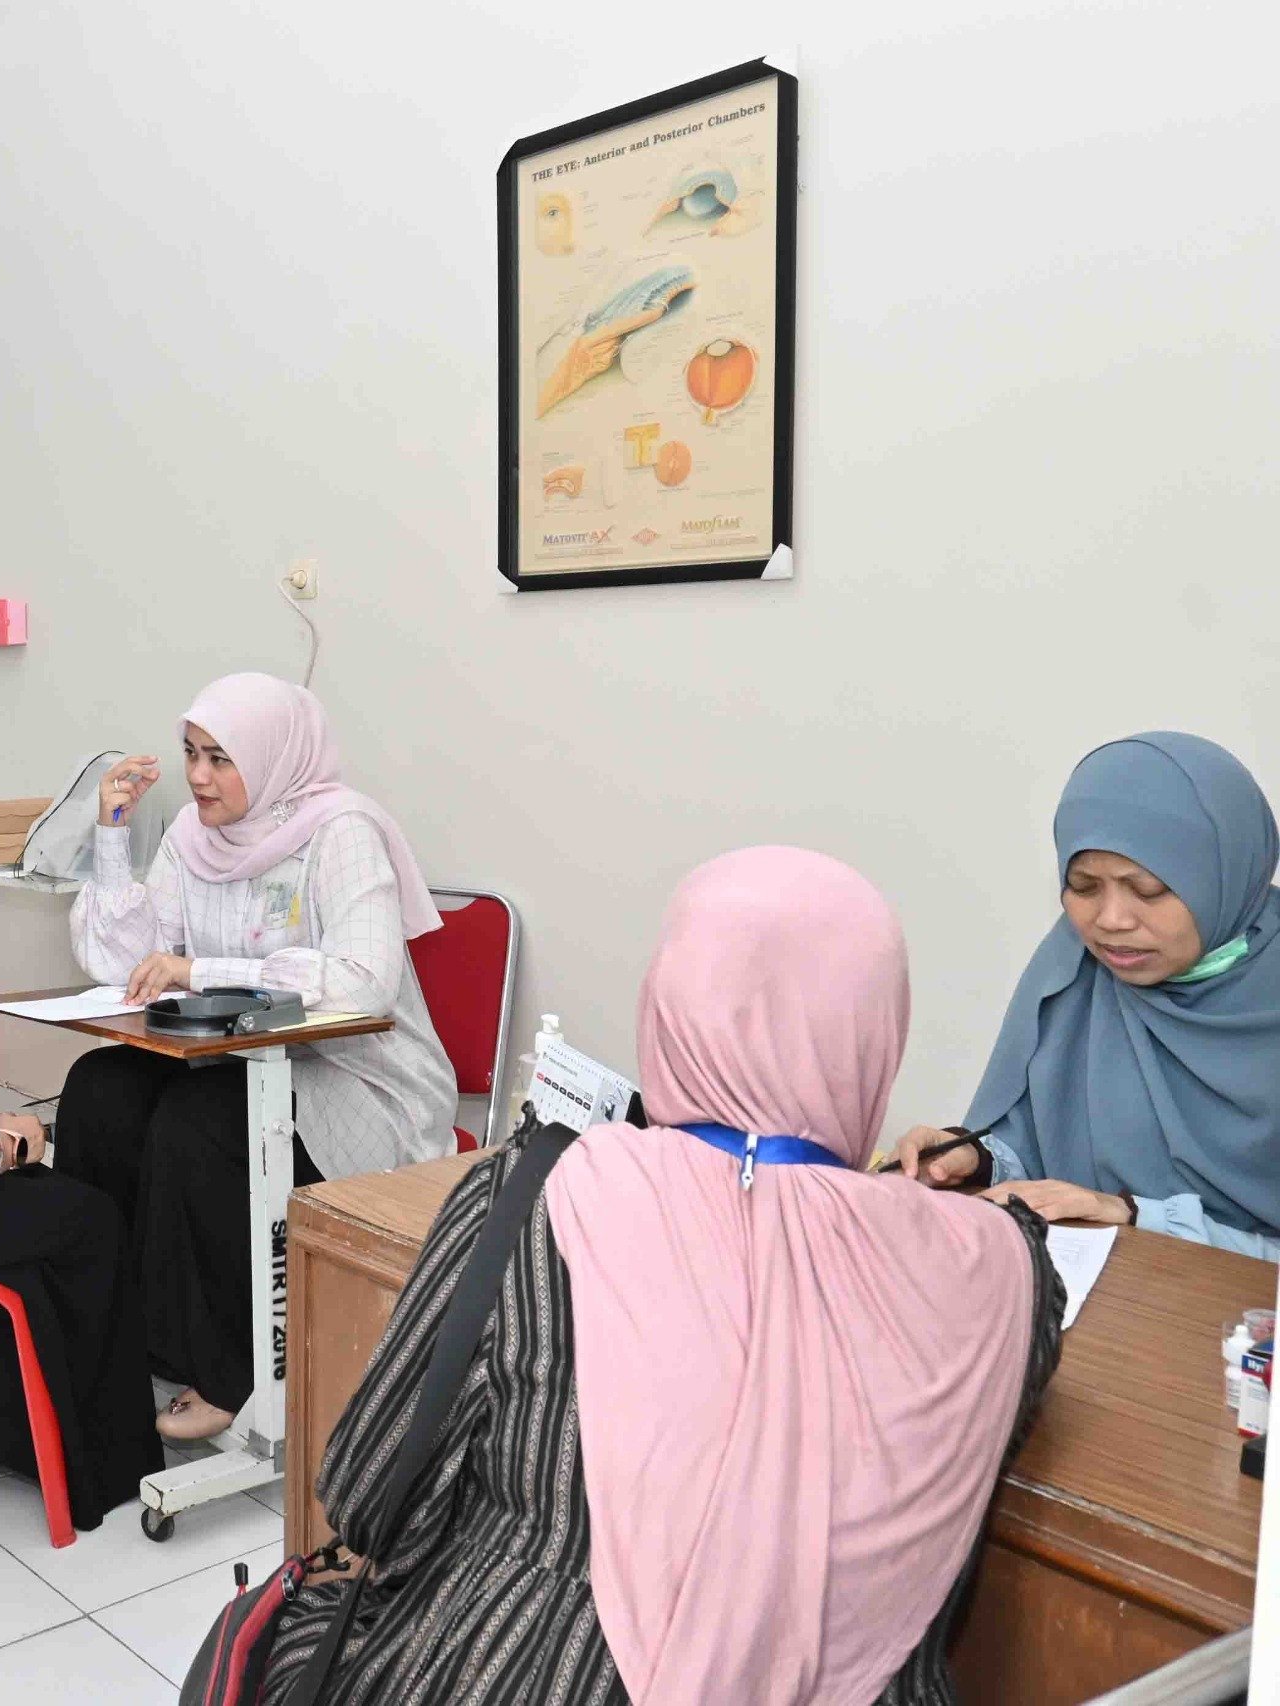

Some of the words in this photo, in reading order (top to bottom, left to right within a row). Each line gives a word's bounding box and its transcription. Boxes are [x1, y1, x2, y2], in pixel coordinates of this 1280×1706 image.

[532, 167, 553, 182] THE
[556, 160, 581, 175] EYE:
[584, 145, 626, 167] Anterior
[629, 136, 649, 152] and
[653, 121, 704, 145] Posterior
[708, 102, 766, 128] Chambers
